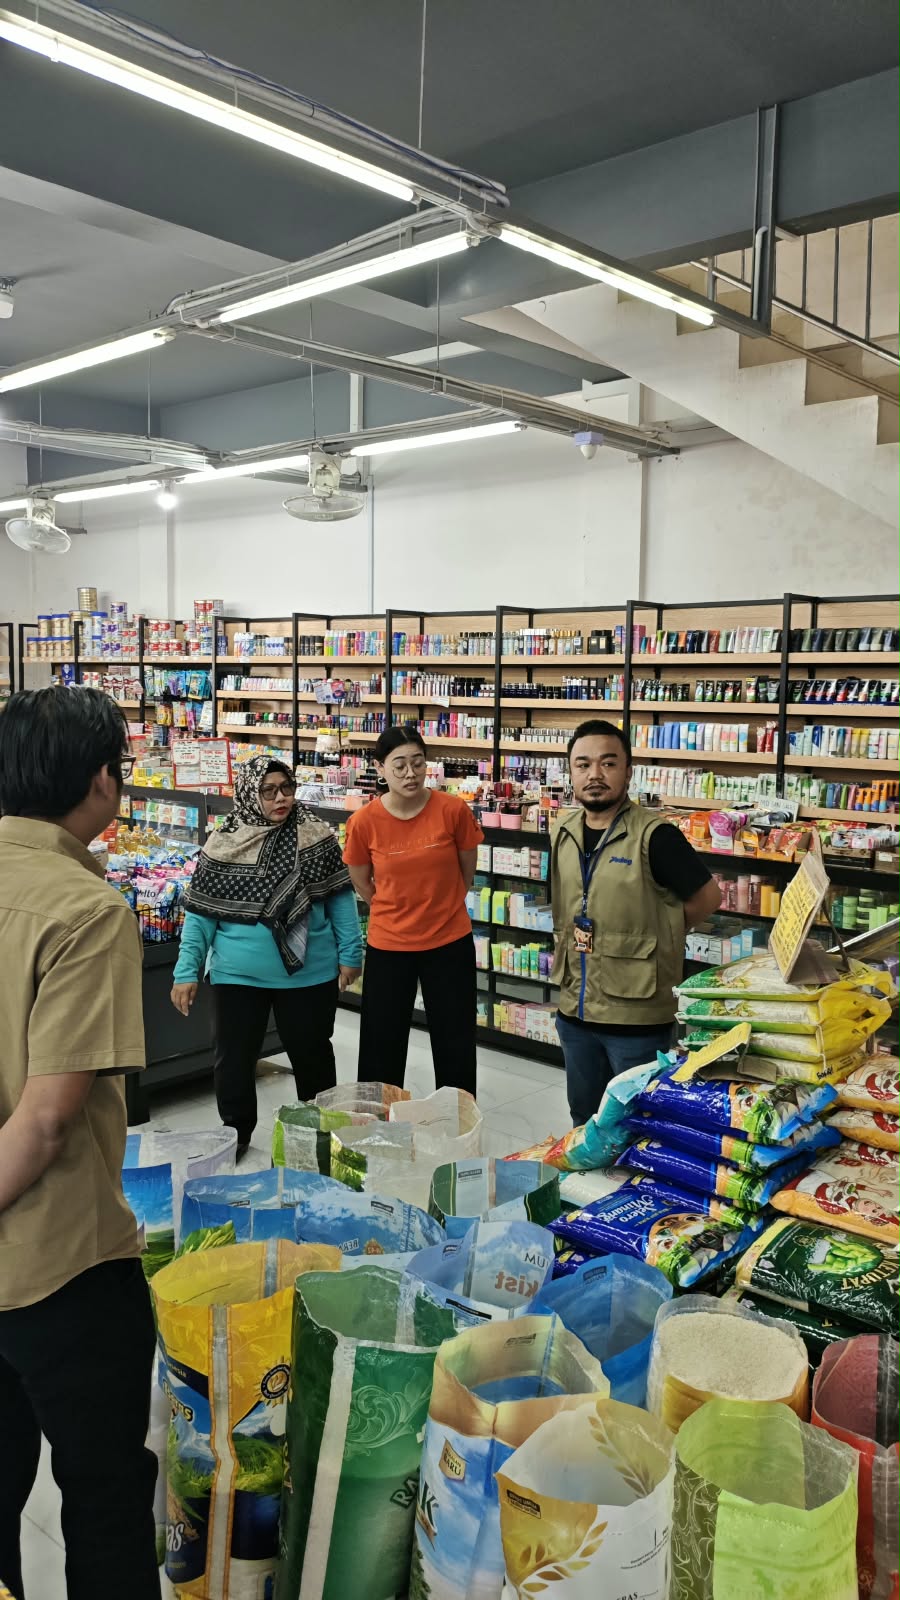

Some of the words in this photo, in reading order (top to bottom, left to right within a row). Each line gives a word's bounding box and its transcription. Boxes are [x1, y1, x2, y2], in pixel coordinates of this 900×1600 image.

[597, 1194, 655, 1223] Minang
[841, 1259, 899, 1290] KETUPAT
[443, 1454, 462, 1476] BARU
[390, 1476, 420, 1509] RA
